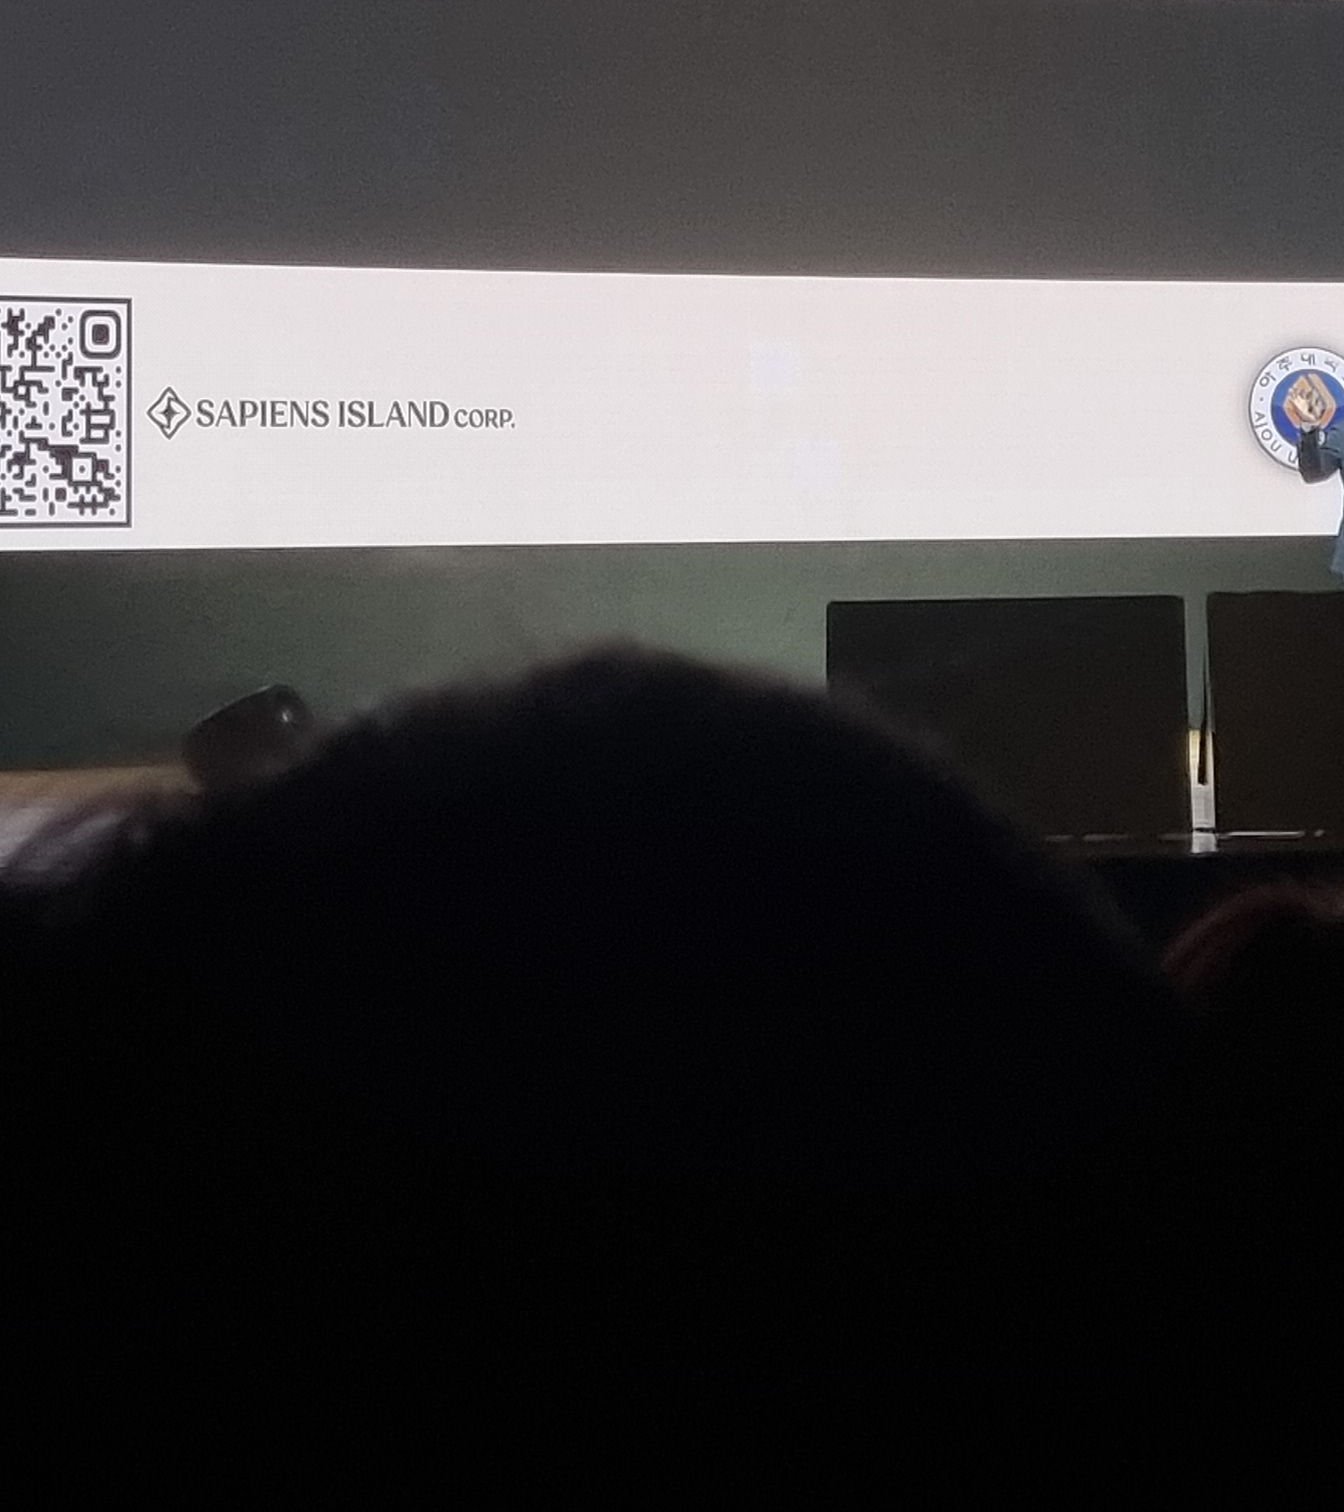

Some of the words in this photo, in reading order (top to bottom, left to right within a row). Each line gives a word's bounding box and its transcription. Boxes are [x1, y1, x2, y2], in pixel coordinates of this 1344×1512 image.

[195, 399, 330, 428] SAPIENS
[338, 400, 450, 428] ISLAND
[454, 408, 516, 429] CORP.
